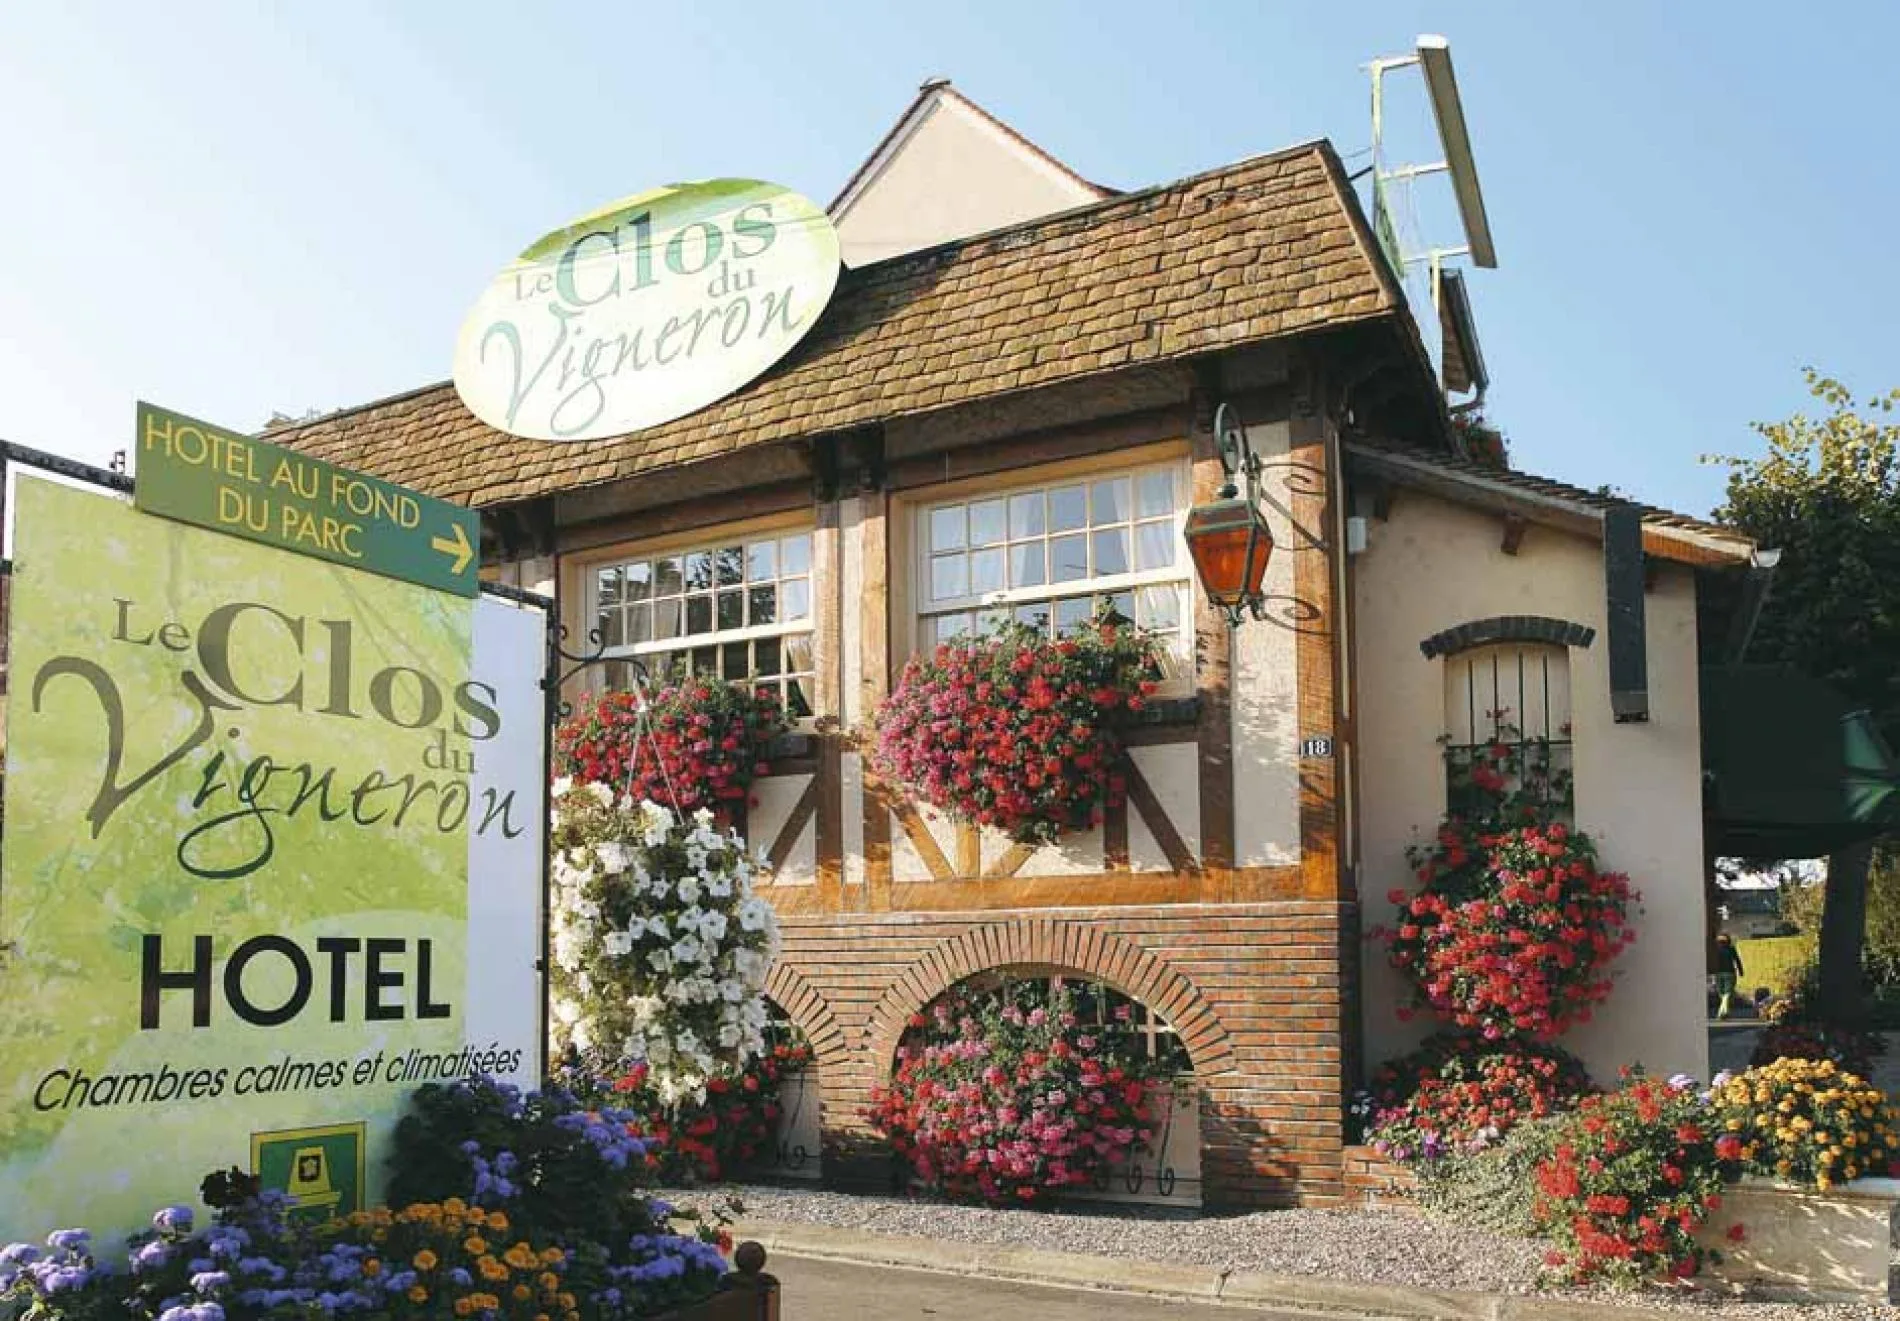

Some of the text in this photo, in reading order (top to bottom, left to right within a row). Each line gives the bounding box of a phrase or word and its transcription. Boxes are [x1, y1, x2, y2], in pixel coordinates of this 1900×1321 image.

[515, 202, 777, 308] Le Clos
[706, 260, 757, 298] du
[480, 285, 804, 436] Vigneron
[145, 413, 421, 529] HOTEL AU FOND
[219, 485, 363, 558] DU PARC
[112, 598, 500, 740] Le Clos
[32, 656, 523, 879] Vigneron
[422, 730, 476, 773] du
[141, 934, 451, 1030] HOTEL
[33, 1042, 522, 1111] Chambres calmes et climatisées
